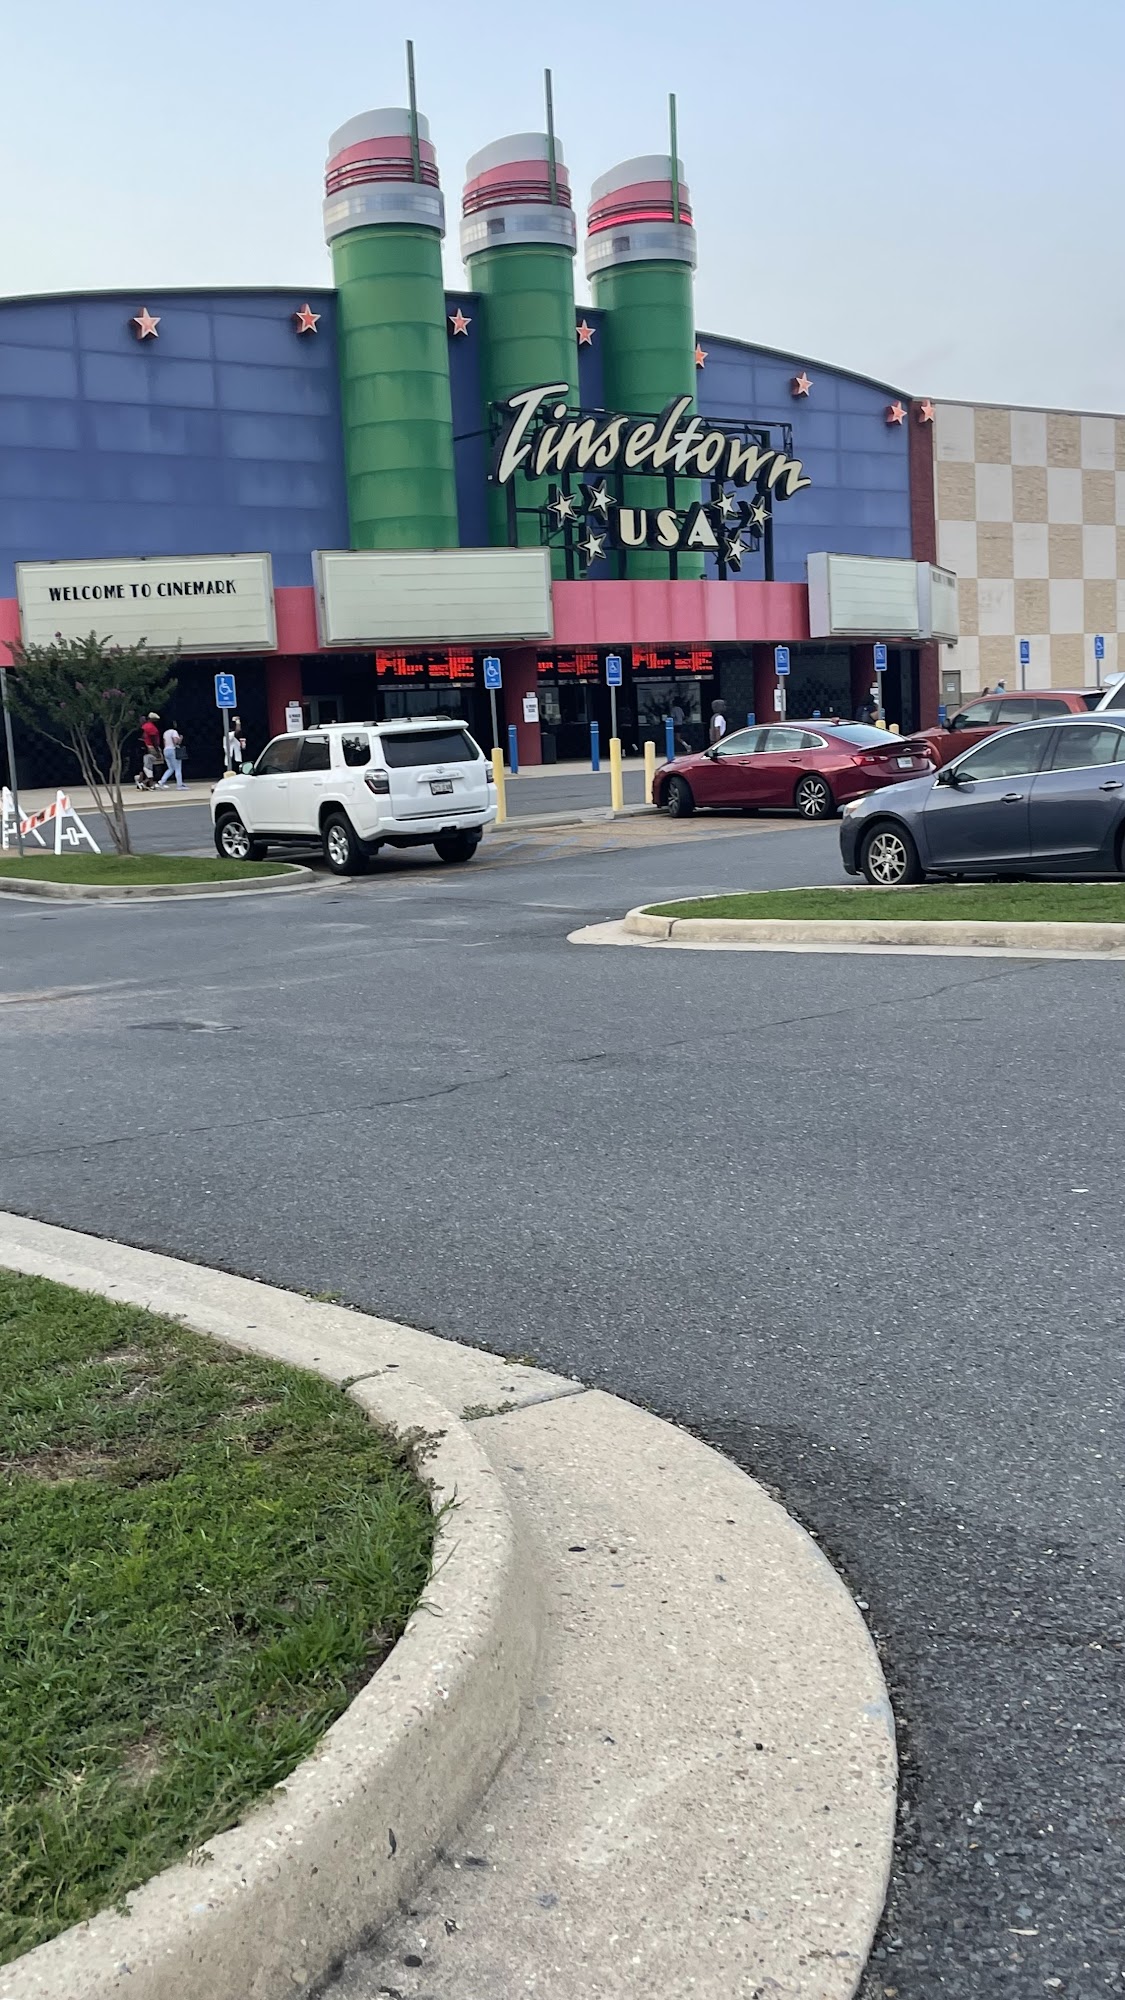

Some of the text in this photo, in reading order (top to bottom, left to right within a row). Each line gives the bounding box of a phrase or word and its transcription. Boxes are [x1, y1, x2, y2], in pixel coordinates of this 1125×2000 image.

[497, 382, 811, 496] Tinseltown
[619, 508, 719, 547] USA
[49, 580, 236, 601] WELCOME TO CINEMARK
